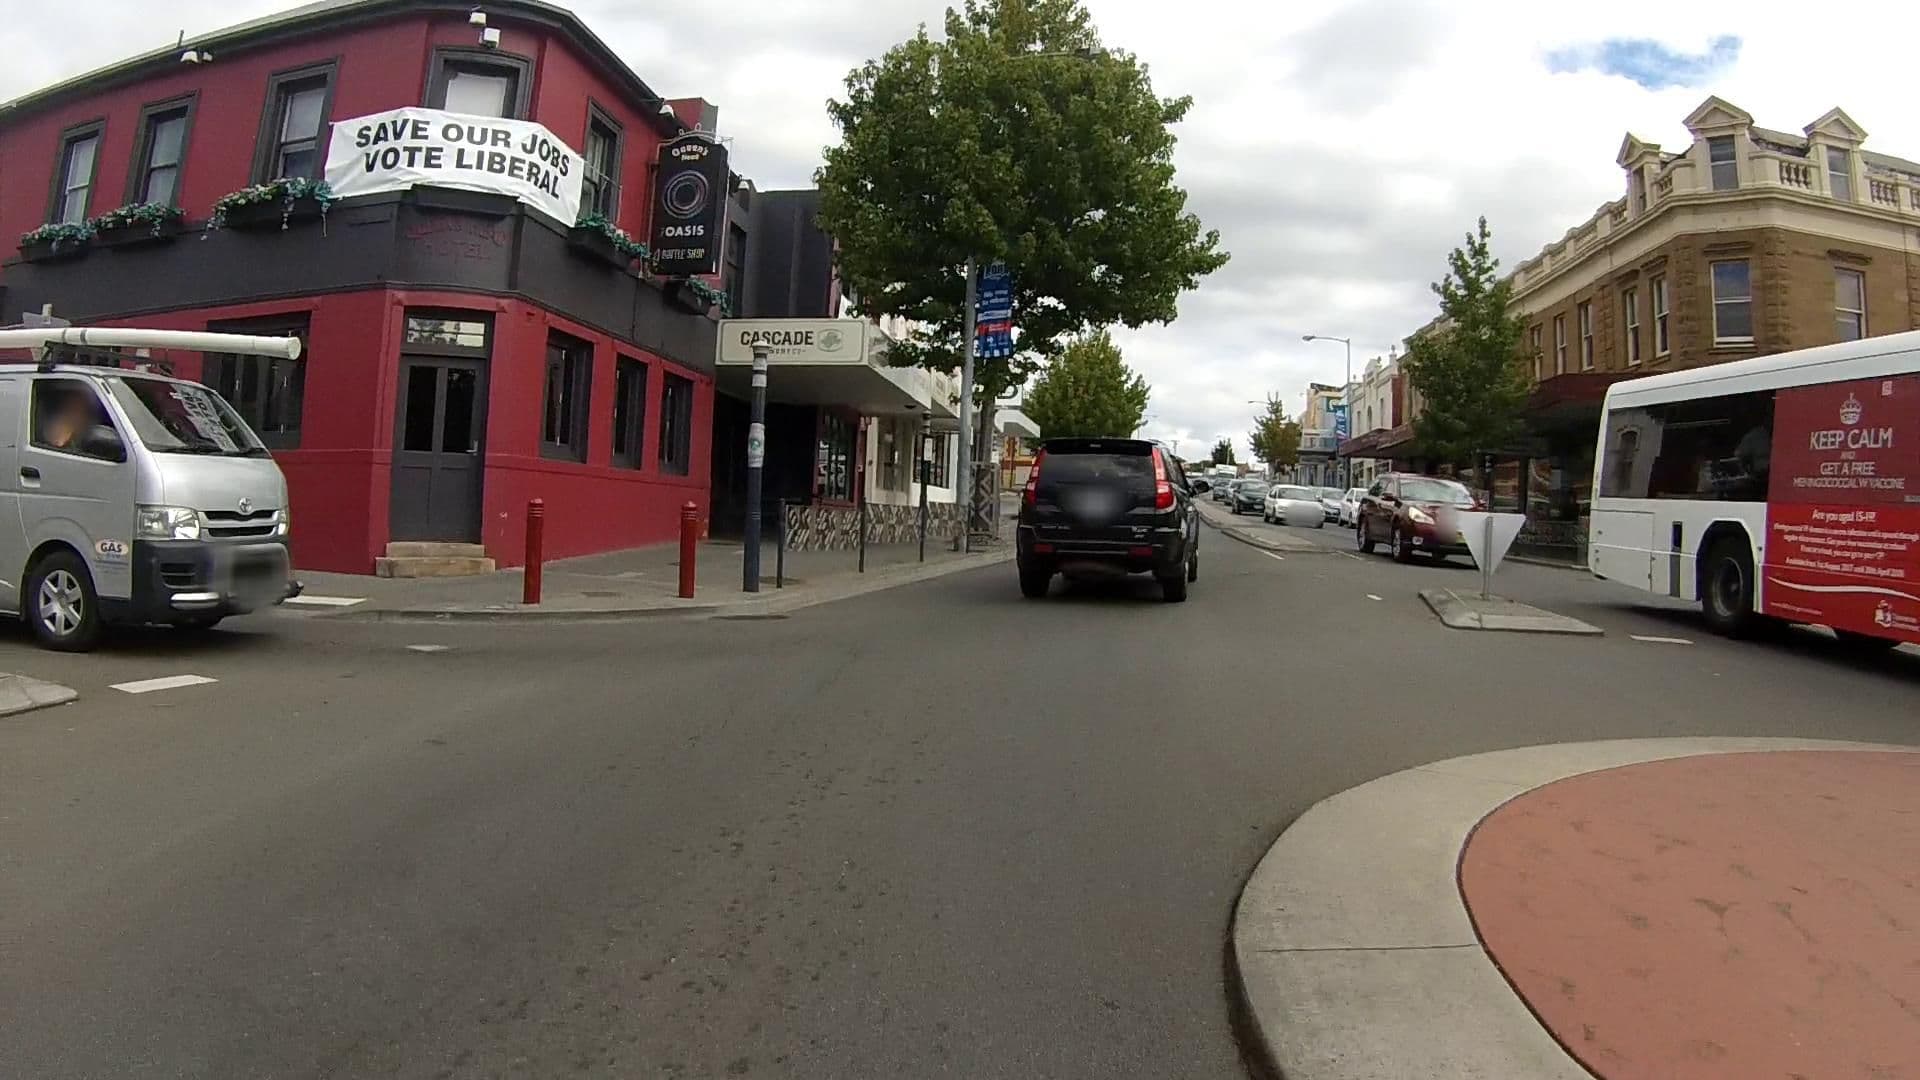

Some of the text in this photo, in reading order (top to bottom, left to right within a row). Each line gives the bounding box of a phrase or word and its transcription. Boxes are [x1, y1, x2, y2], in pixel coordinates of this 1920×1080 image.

[356, 119, 570, 177] SAVE OUR JOBS
[364, 146, 560, 200] VOTE LIBERAL
[665, 225, 704, 237] OASIS
[740, 331, 814, 346] CASCADE
[1809, 427, 1893, 450] KEEP CALM
[1820, 462, 1876, 475] GET A FREE
[100, 542, 122, 553] GAS
